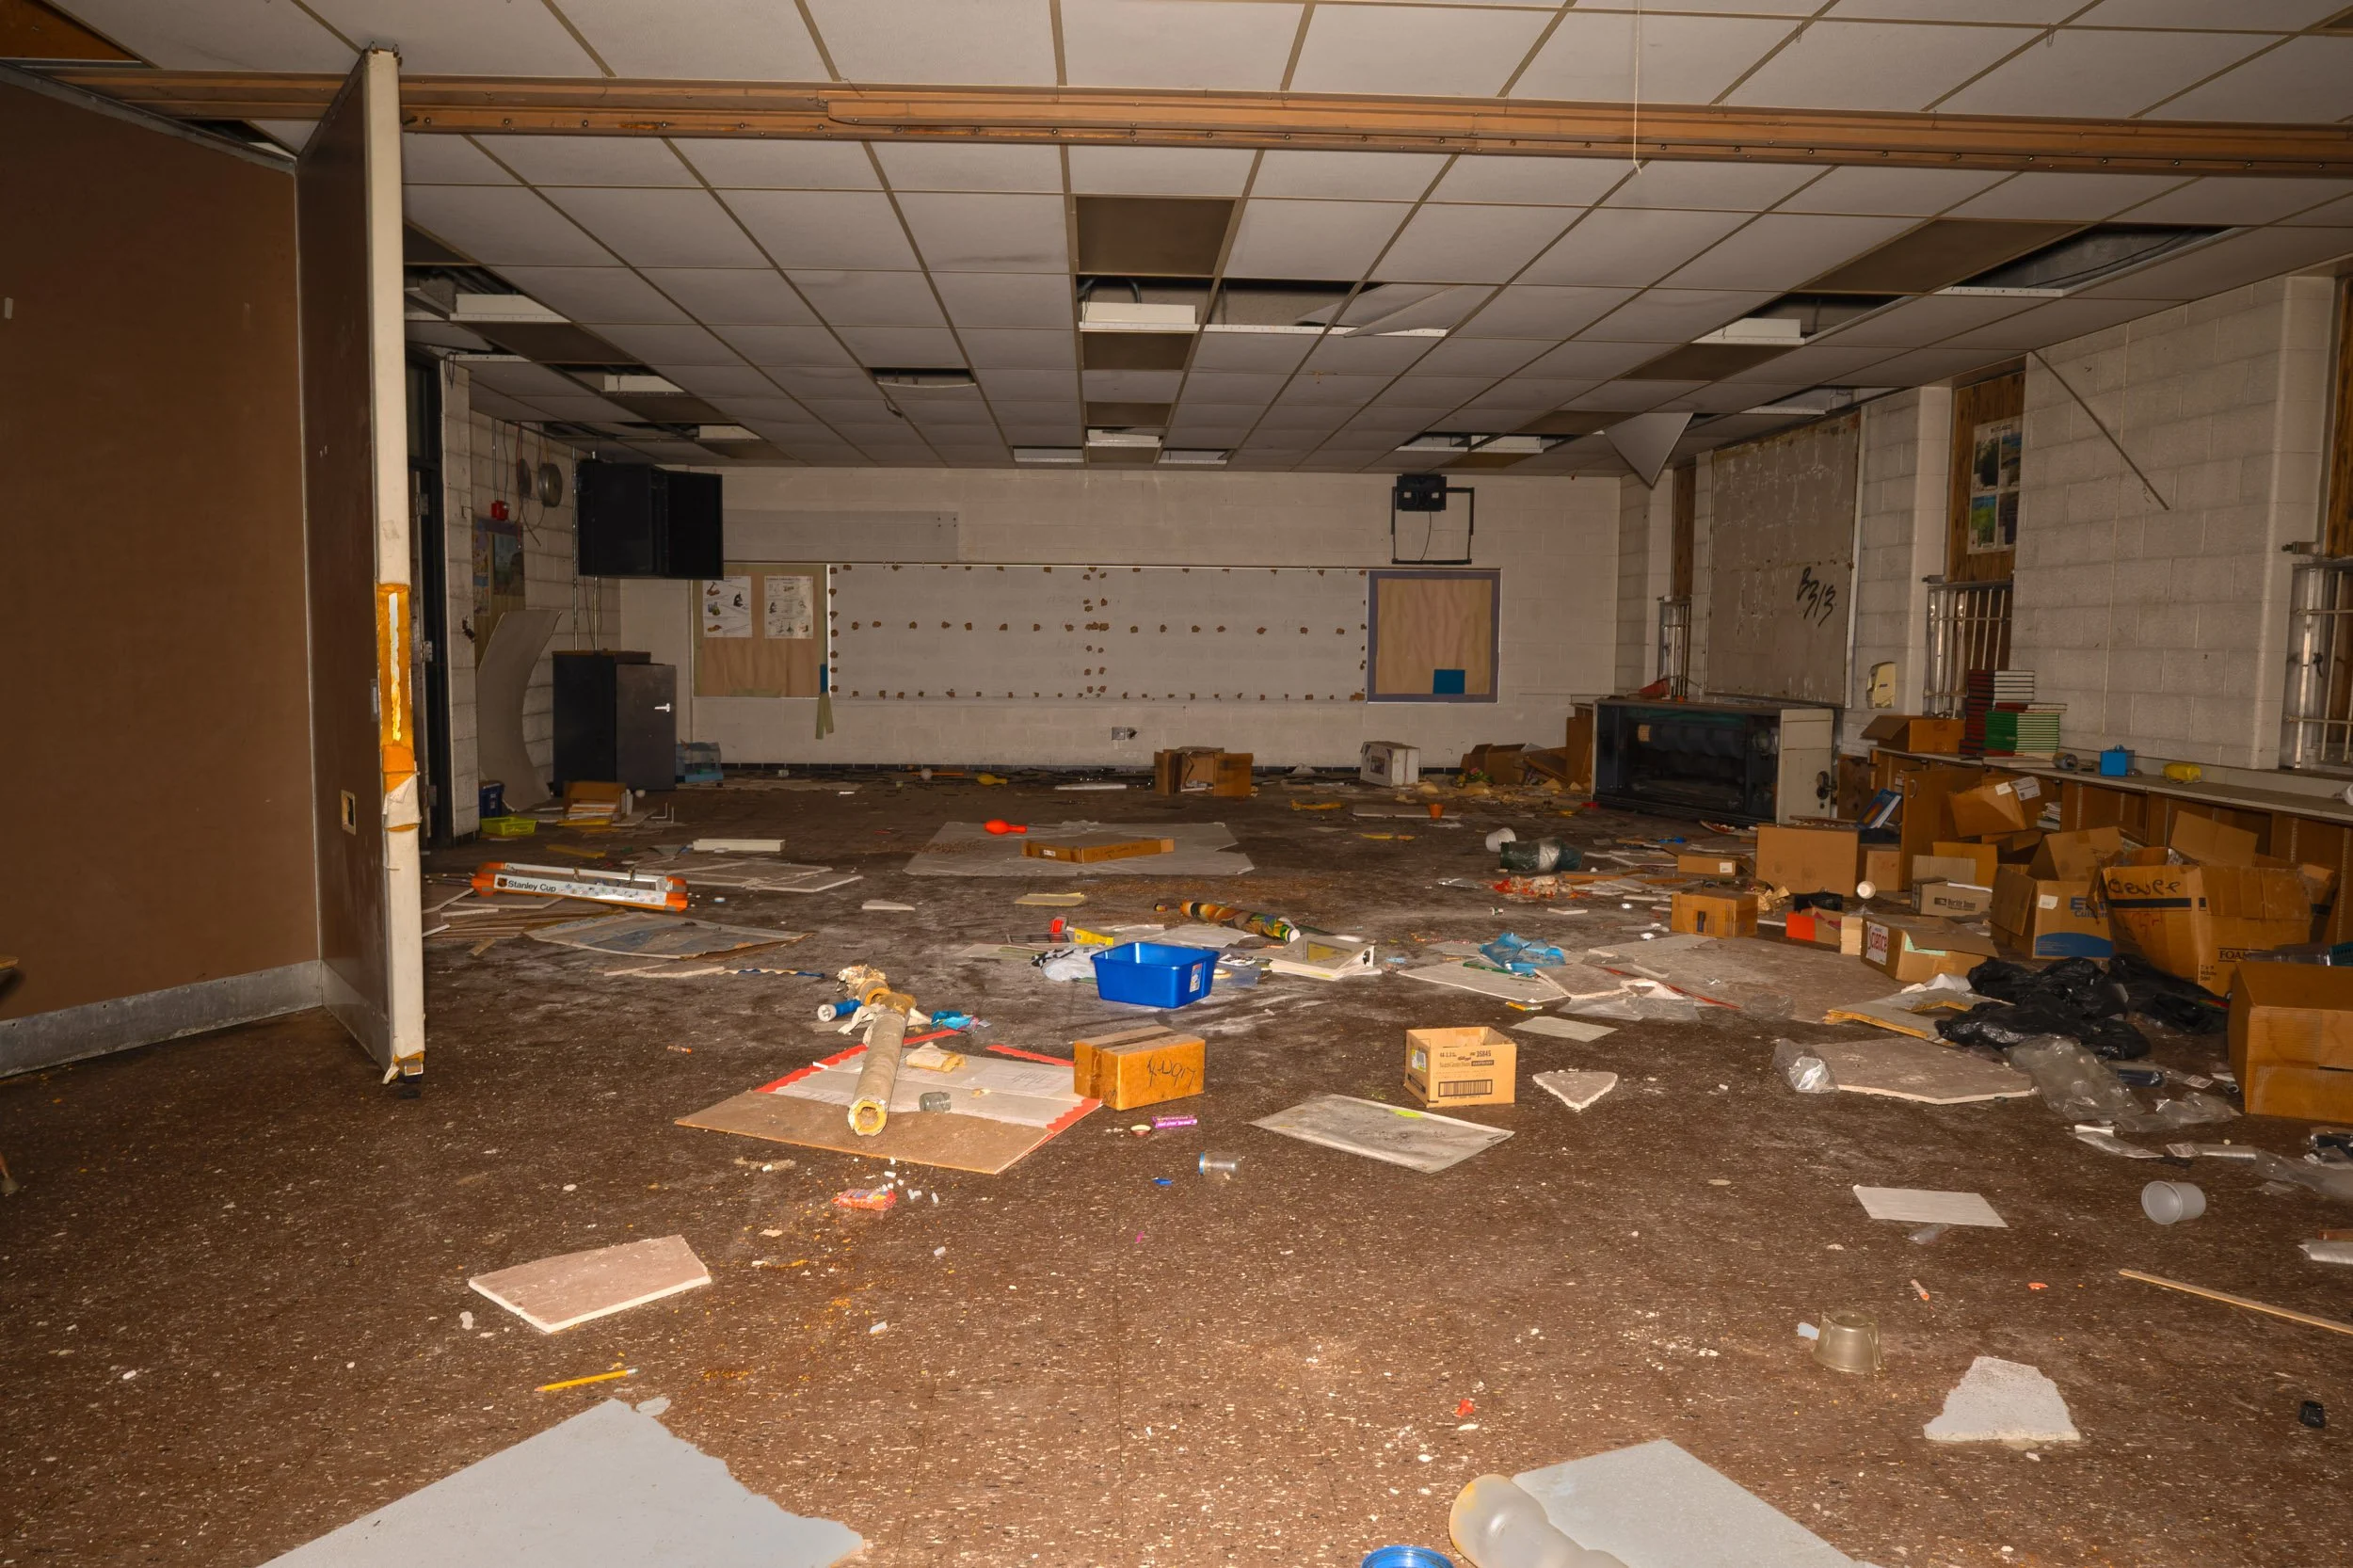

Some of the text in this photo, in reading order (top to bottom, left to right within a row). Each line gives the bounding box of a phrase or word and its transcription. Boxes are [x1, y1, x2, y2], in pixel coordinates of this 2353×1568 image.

[508, 879, 556, 893] Stanley Cup
[1867, 926, 1887, 952] Science
